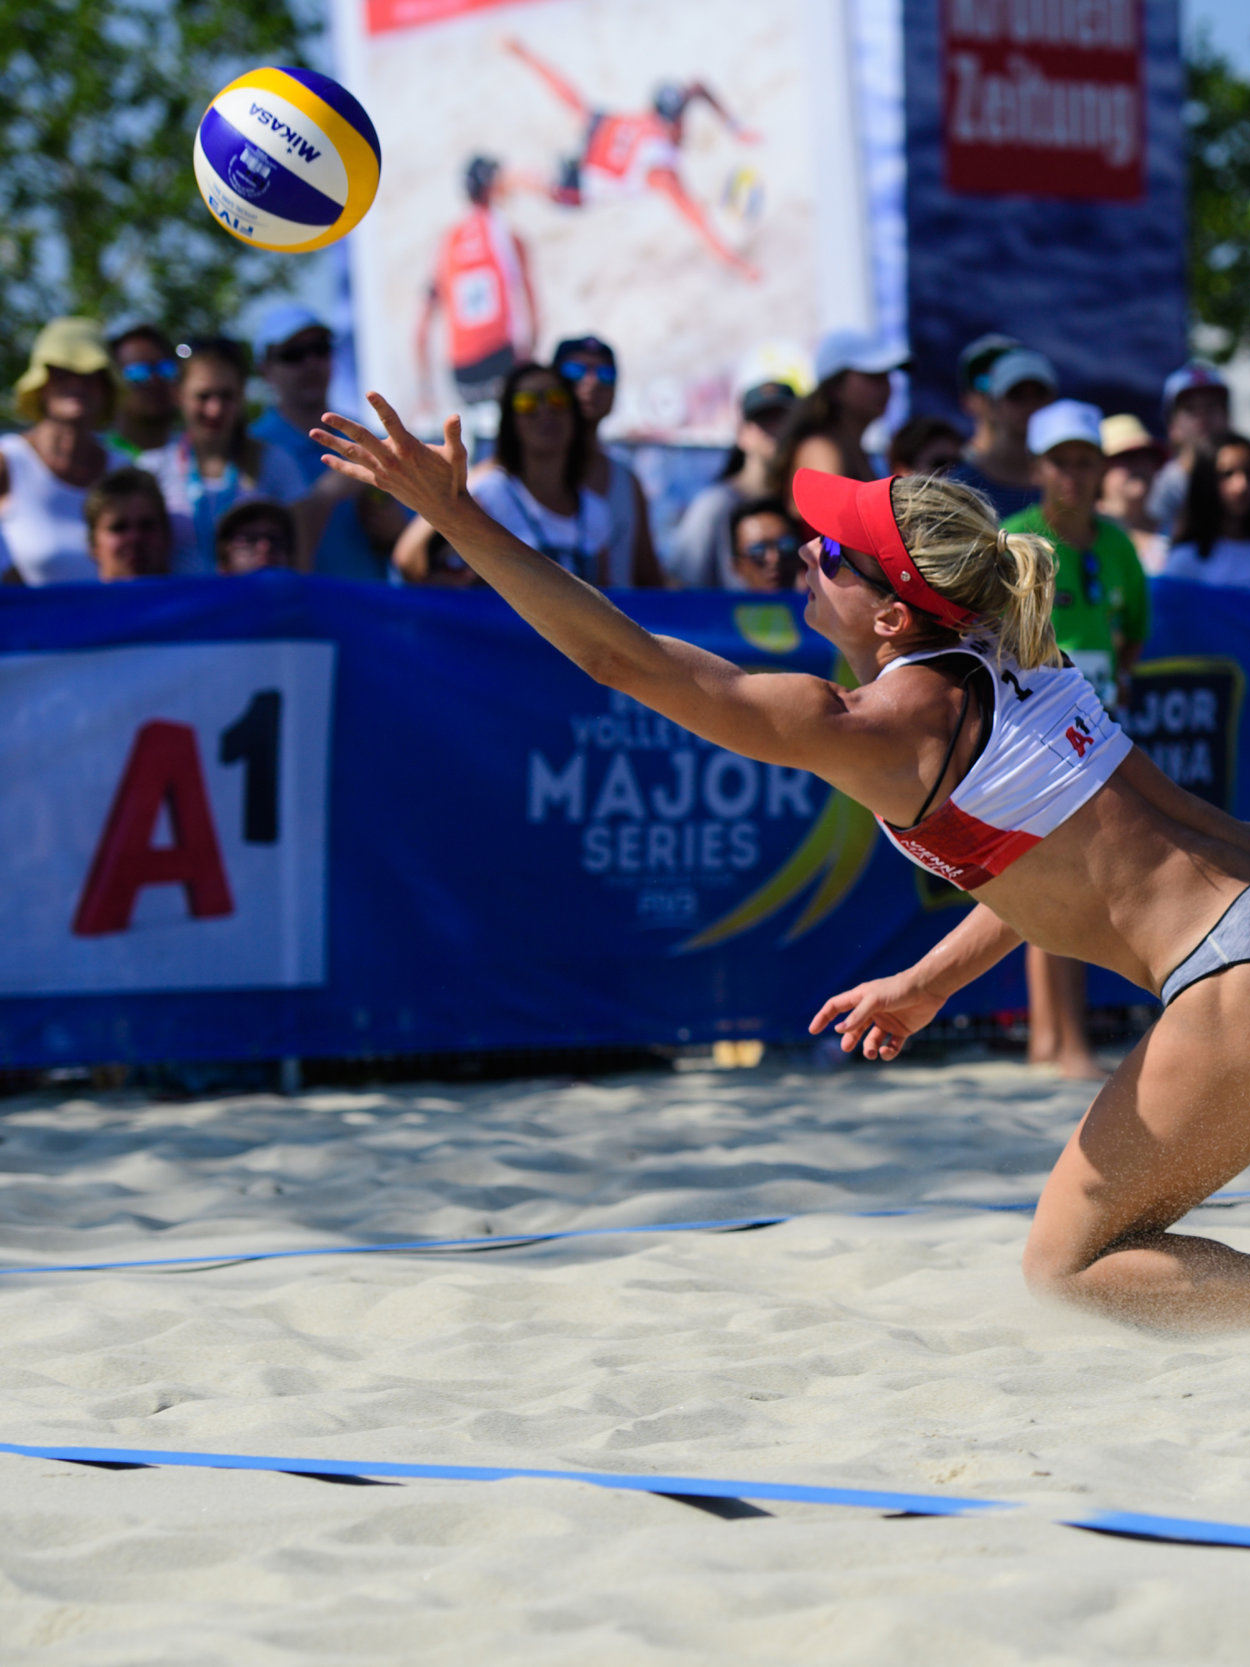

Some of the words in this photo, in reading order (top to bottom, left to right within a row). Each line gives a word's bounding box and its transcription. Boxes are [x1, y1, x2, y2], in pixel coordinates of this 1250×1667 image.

[952, 55, 1134, 166] Zeitung
[1066, 716, 1095, 758] A1
[70, 689, 283, 937] A1
[528, 750, 813, 821] MAJOR
[583, 823, 757, 871] SERIES
